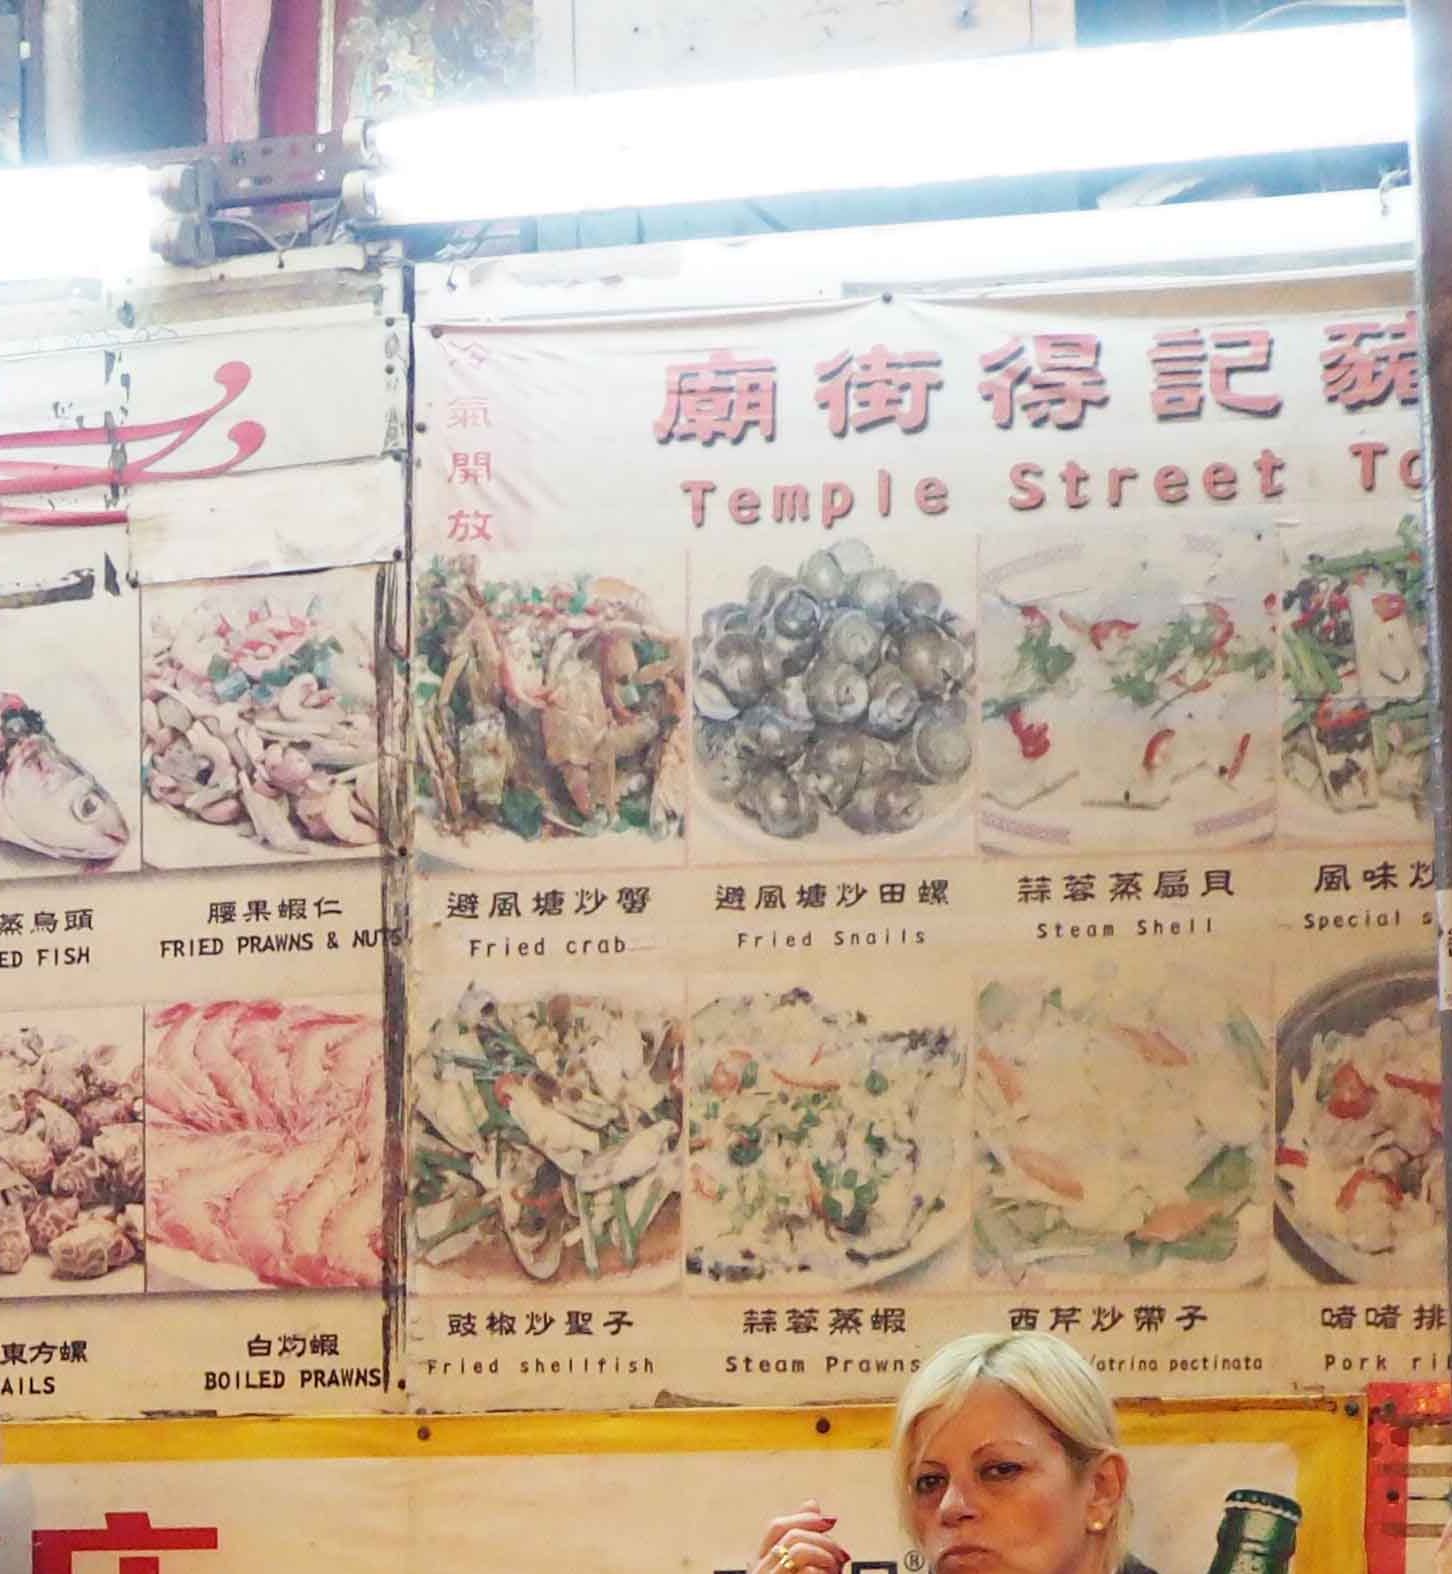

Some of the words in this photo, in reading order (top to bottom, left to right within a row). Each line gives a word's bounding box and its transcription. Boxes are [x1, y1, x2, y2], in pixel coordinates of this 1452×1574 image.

[681, 469, 951, 528] Temple
[1007, 449, 1286, 510] Street
[447, 887, 650, 919] 避風塘炒蟹
[716, 880, 949, 911] 避風塘炒田螺
[1037, 922, 1114, 939] Steam
[1137, 918, 1213, 936] Shell
[1304, 910, 1400, 931] Special
[160, 937, 225, 959] FRIED
[237, 931, 314, 955] PRAWNS
[326, 930, 340, 949] &
[469, 936, 546, 958] Fried
[566, 935, 627, 955] crab
[738, 930, 812, 949] Fried
[834, 927, 926, 947] Snails
[37, 946, 91, 967] FISH
[427, 1357, 499, 1376] Fried
[520, 1356, 655, 1376] shellfish
[726, 1356, 806, 1374] Steam
[826, 1355, 922, 1375] Prawns
[1325, 1353, 1387, 1372] Pork
[1411, 1352, 1452, 1371] ri
[203, 1369, 286, 1391] BOILED
[299, 1366, 383, 1389] PRAWNS
